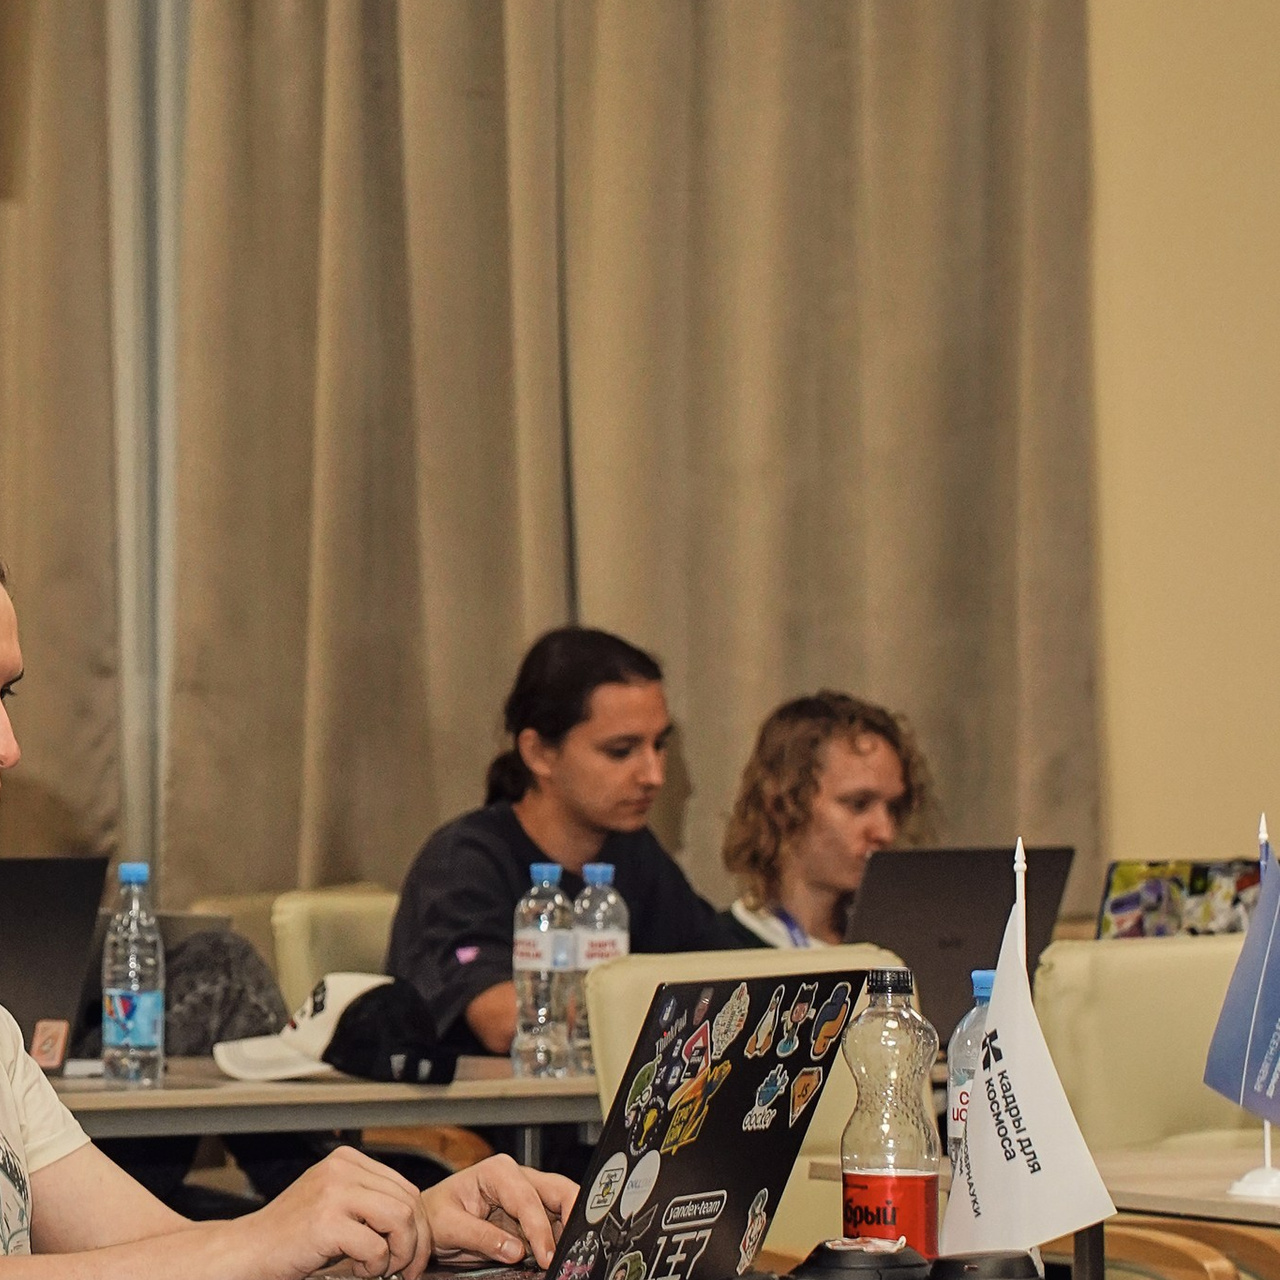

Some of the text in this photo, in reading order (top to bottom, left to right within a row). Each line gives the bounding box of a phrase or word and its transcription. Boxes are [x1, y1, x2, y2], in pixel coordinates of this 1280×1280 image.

[797, 1082, 810, 1099] JS
[743, 1109, 777, 1128] docker
[985, 1077, 1016, 1161] космоса
[997, 1069, 1042, 1174] кадры для
[666, 1199, 721, 1223] yandex-team
[843, 1197, 897, 1228] брый
